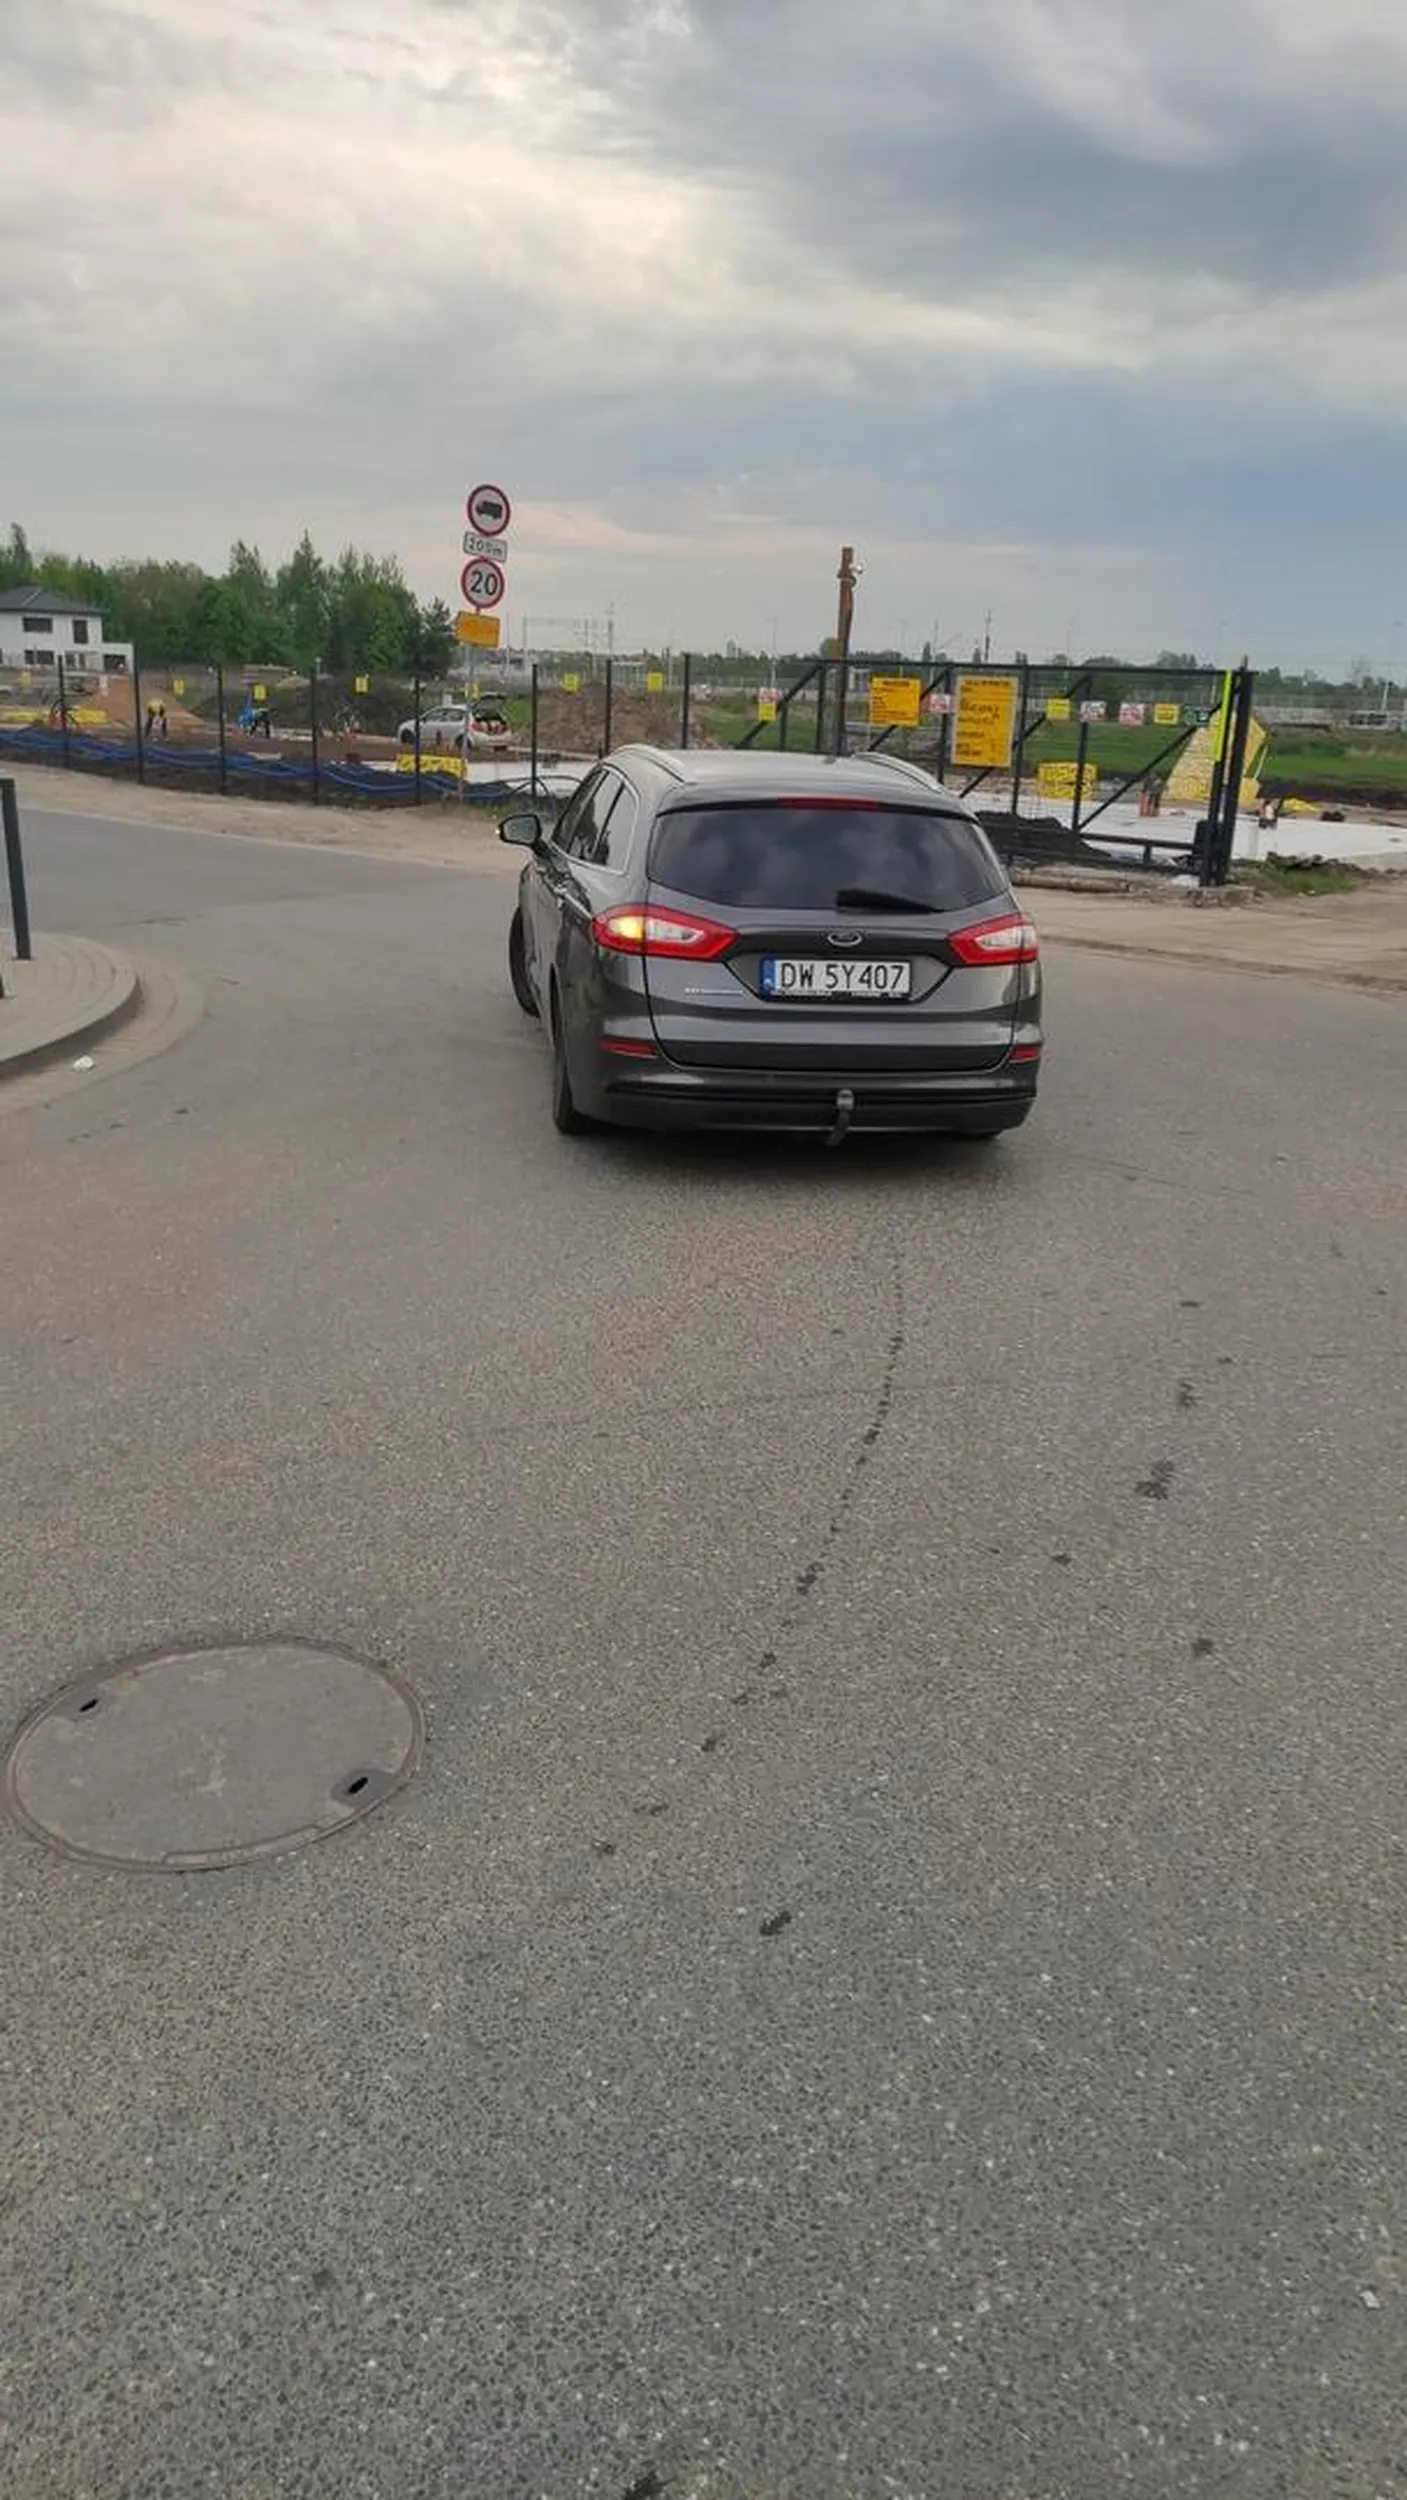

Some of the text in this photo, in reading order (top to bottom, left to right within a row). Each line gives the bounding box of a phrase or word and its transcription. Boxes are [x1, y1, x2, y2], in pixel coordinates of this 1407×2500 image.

[471, 570, 498, 595] 20
[781, 962, 815, 988] DW
[825, 963, 905, 989] 5Y407
